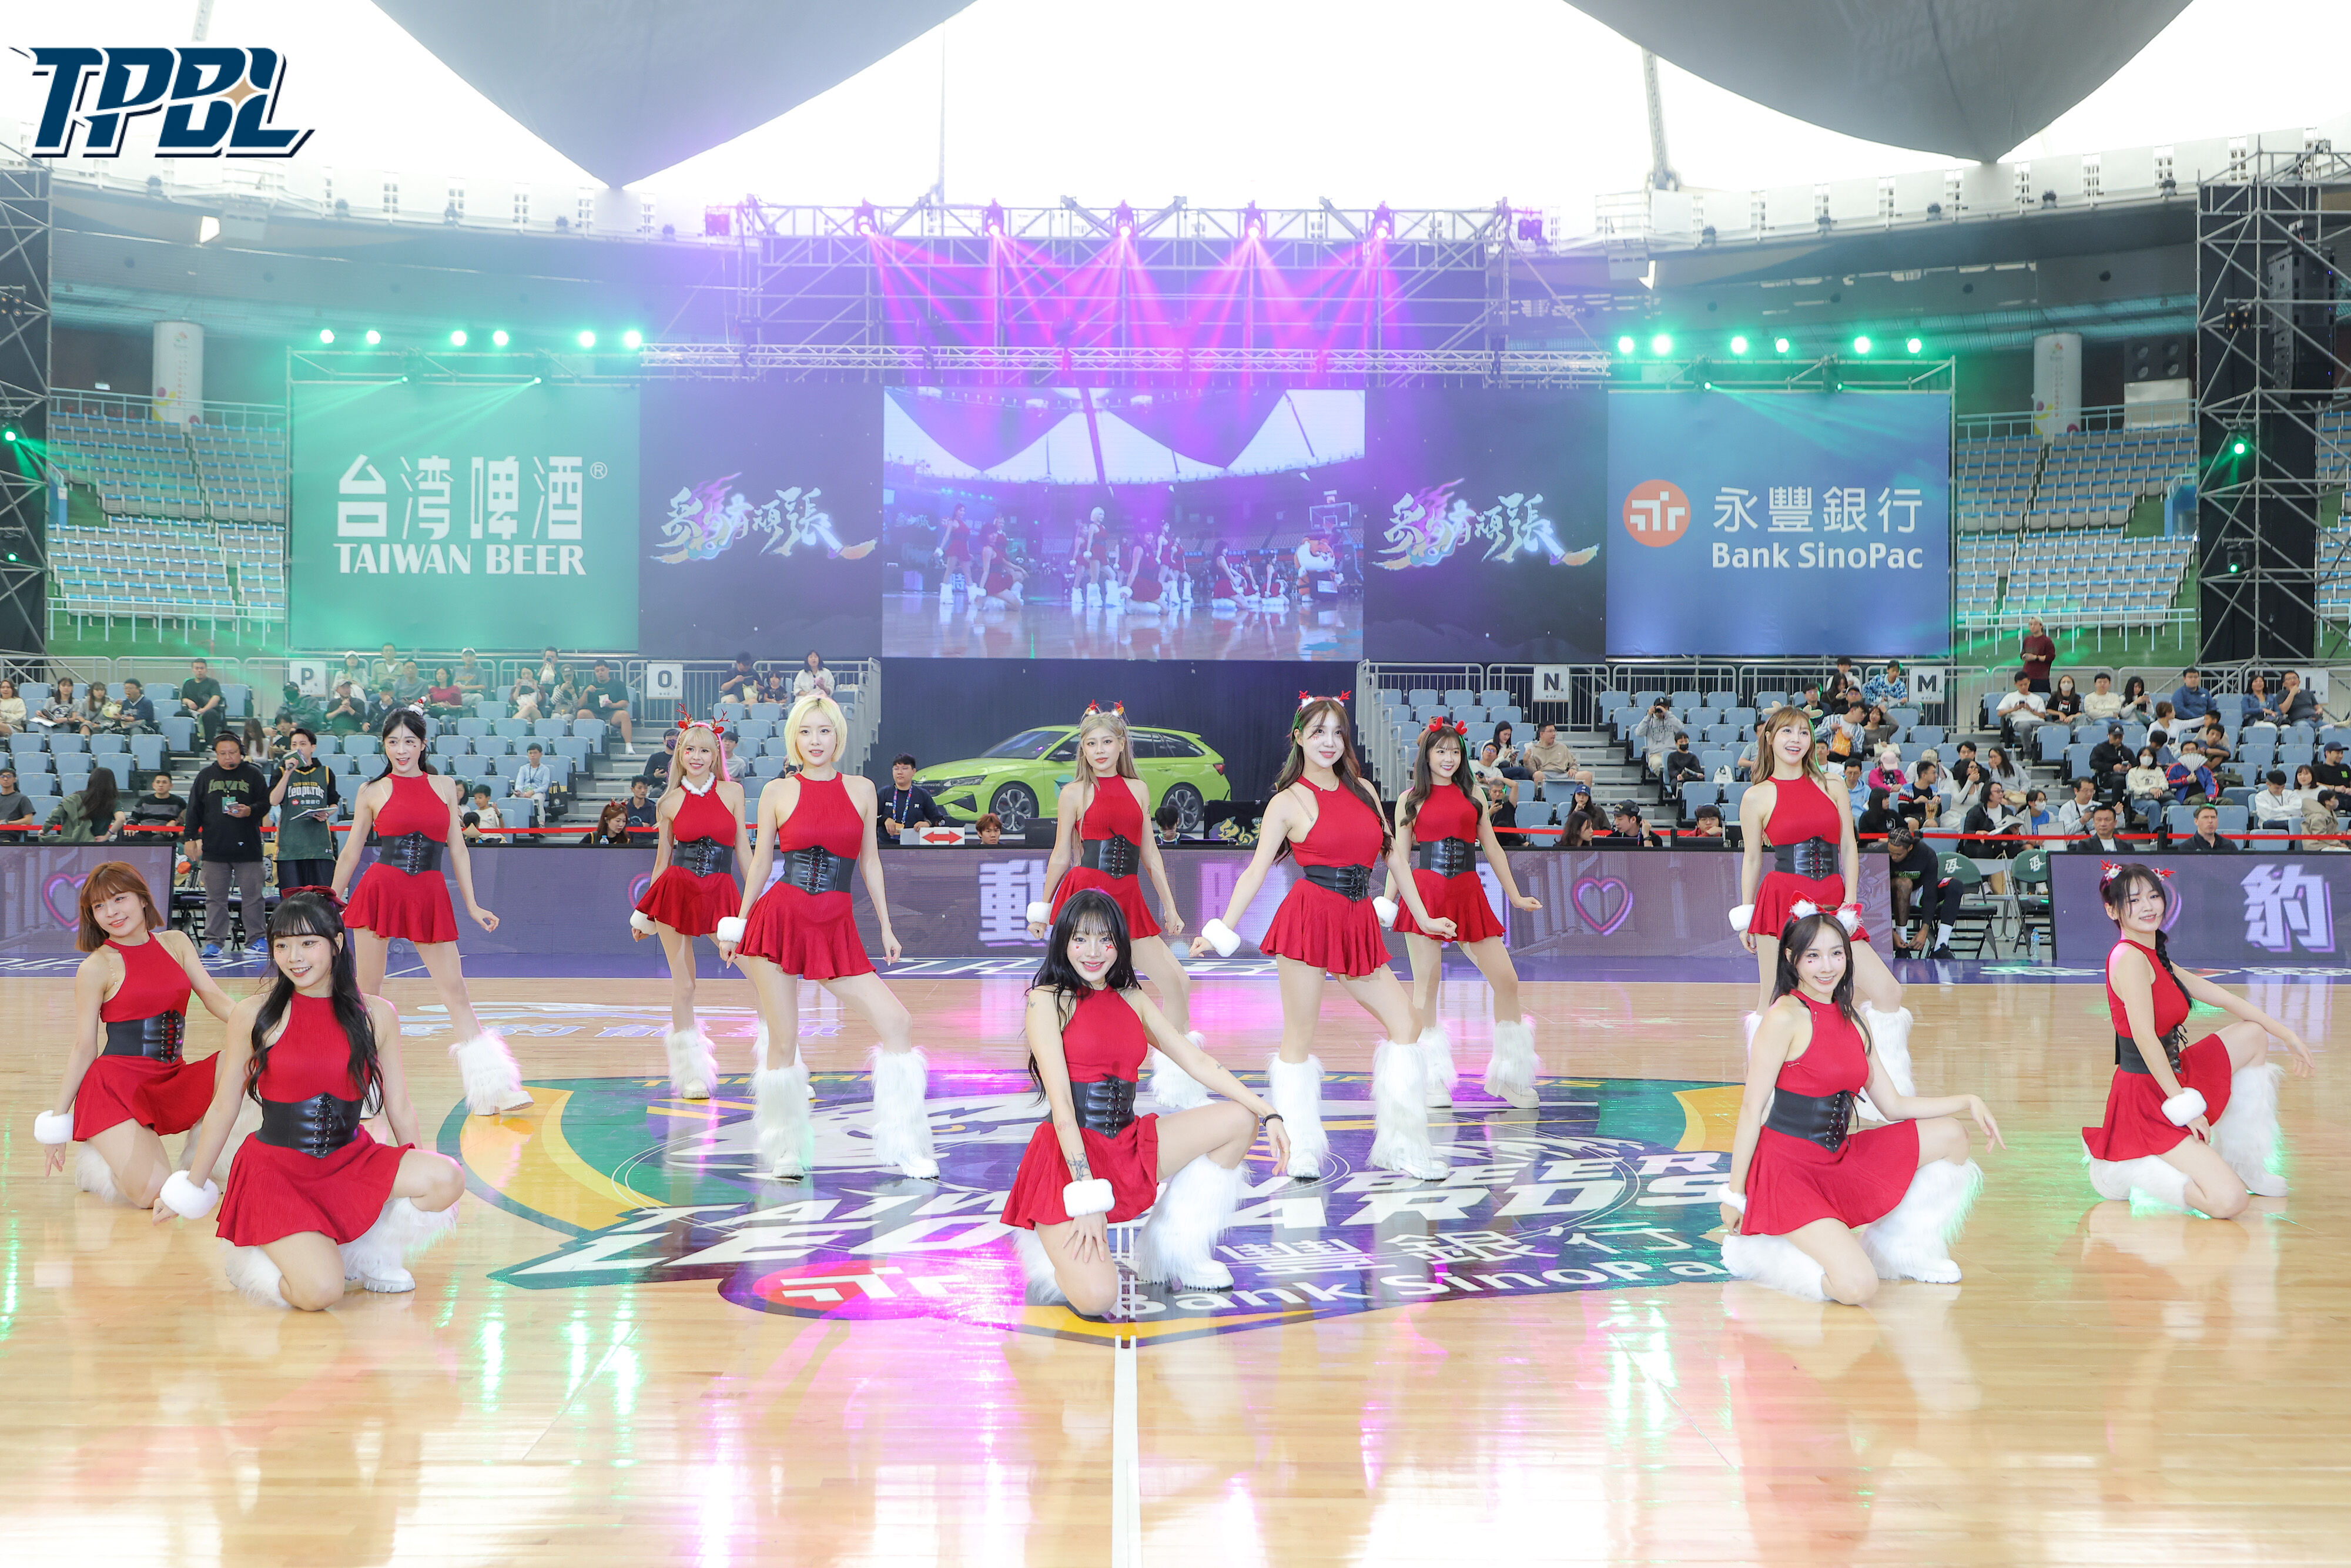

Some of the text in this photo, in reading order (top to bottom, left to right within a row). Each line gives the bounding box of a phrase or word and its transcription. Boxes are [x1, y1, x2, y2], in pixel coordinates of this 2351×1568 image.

[1713, 485, 1923, 533] 永豐銀行
[333, 543, 587, 575] TAIWAN BEER
[1712, 541, 1923, 569] Bank SinoPac
[301, 668, 314, 685] P
[1543, 672, 1559, 690] N
[1917, 674, 1937, 692] M
[288, 785, 324, 799] Leopards
[2240, 863, 2335, 951] 豹
[513, 1174, 1730, 1275] LEOARDS
[1217, 1222, 1693, 1276] 豐銀行
[1380, 1259, 1730, 1296] SinoPa
